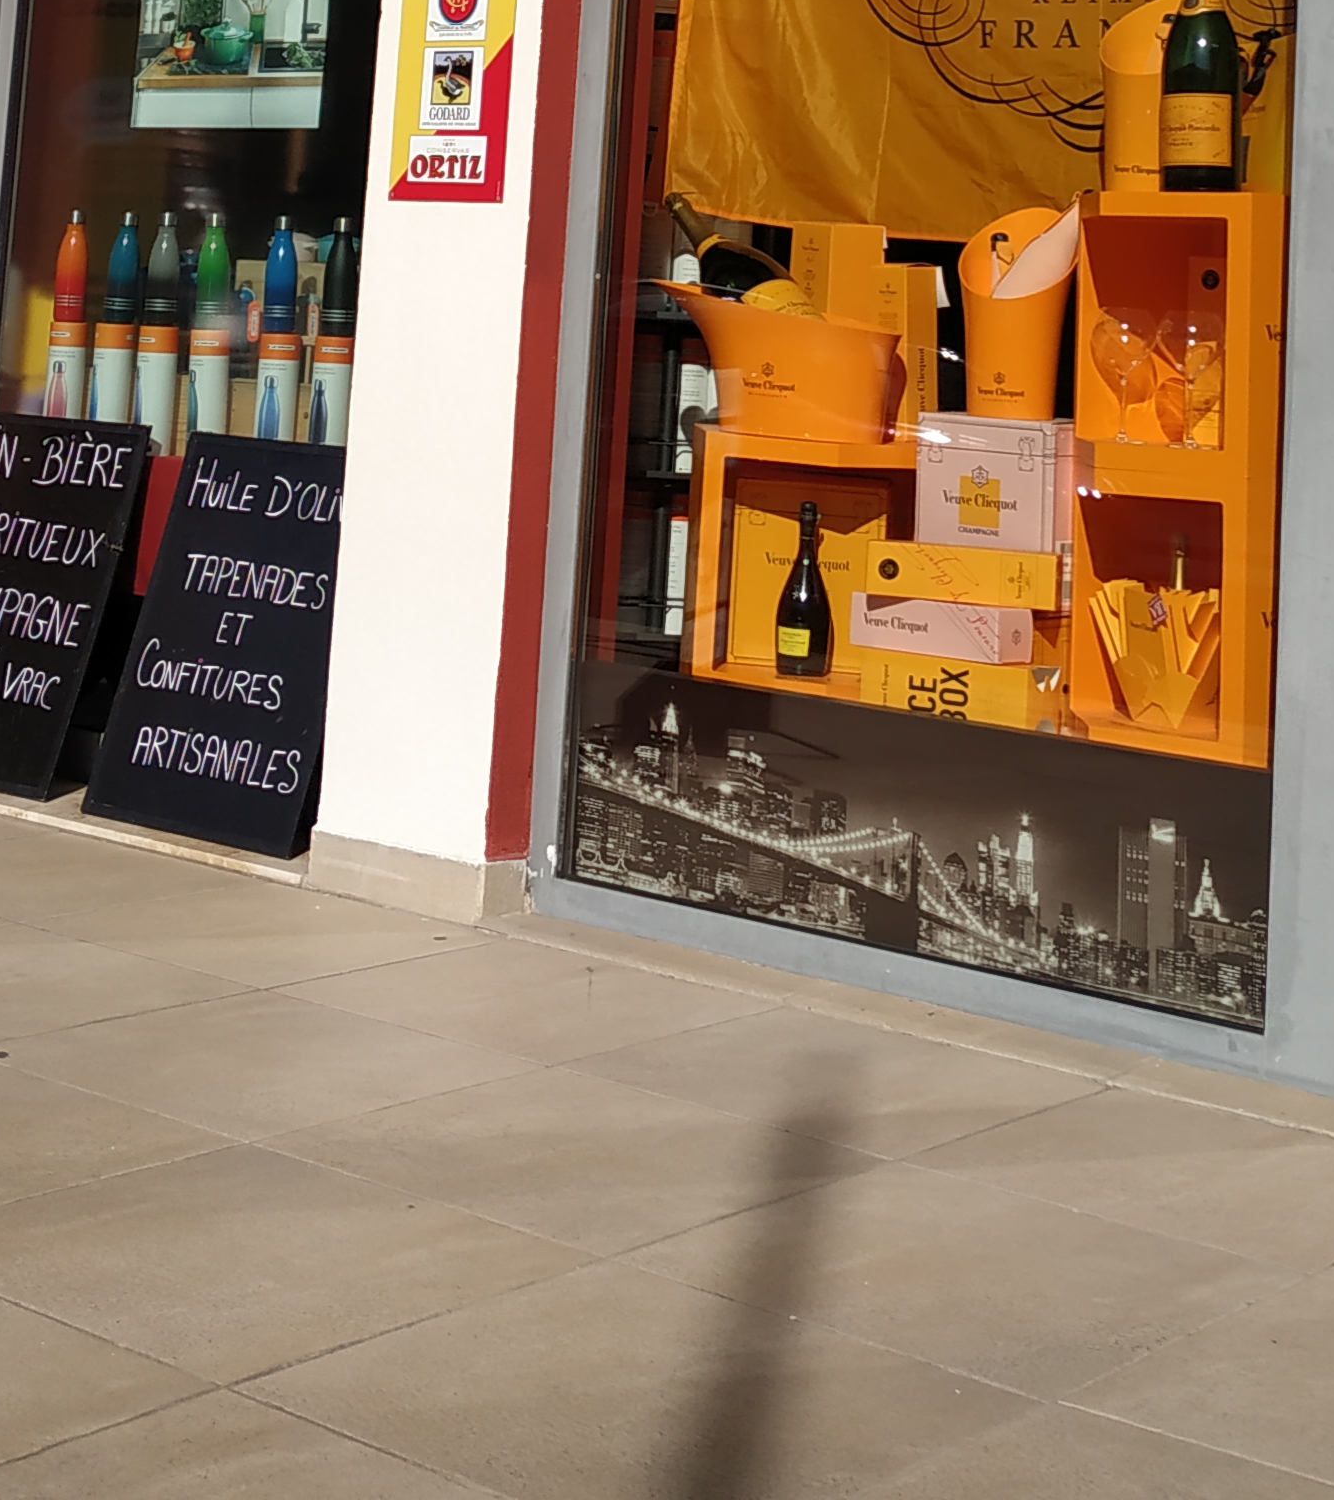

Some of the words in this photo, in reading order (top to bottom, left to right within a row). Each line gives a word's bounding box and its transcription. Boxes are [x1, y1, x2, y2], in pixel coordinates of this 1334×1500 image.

[429, 106, 470, 121] GODARD
[410, 153, 482, 179] ORTIZ
[31, 429, 134, 489] BIÈRE
[942, 489, 973, 506] Veuve
[974, 493, 1018, 513] Clicquot
[958, 526, 1000, 537] CHAMPAGNE
[182, 552, 330, 611] TAPENADES
[215, 612, 254, 647] ET
[863, 612, 890, 629] Veuve
[891, 615, 929, 634] Clicquot
[3, 662, 62, 710] VRAC
[136, 637, 285, 712] CONFITURES
[131, 725, 302, 795] ARTISANALES
